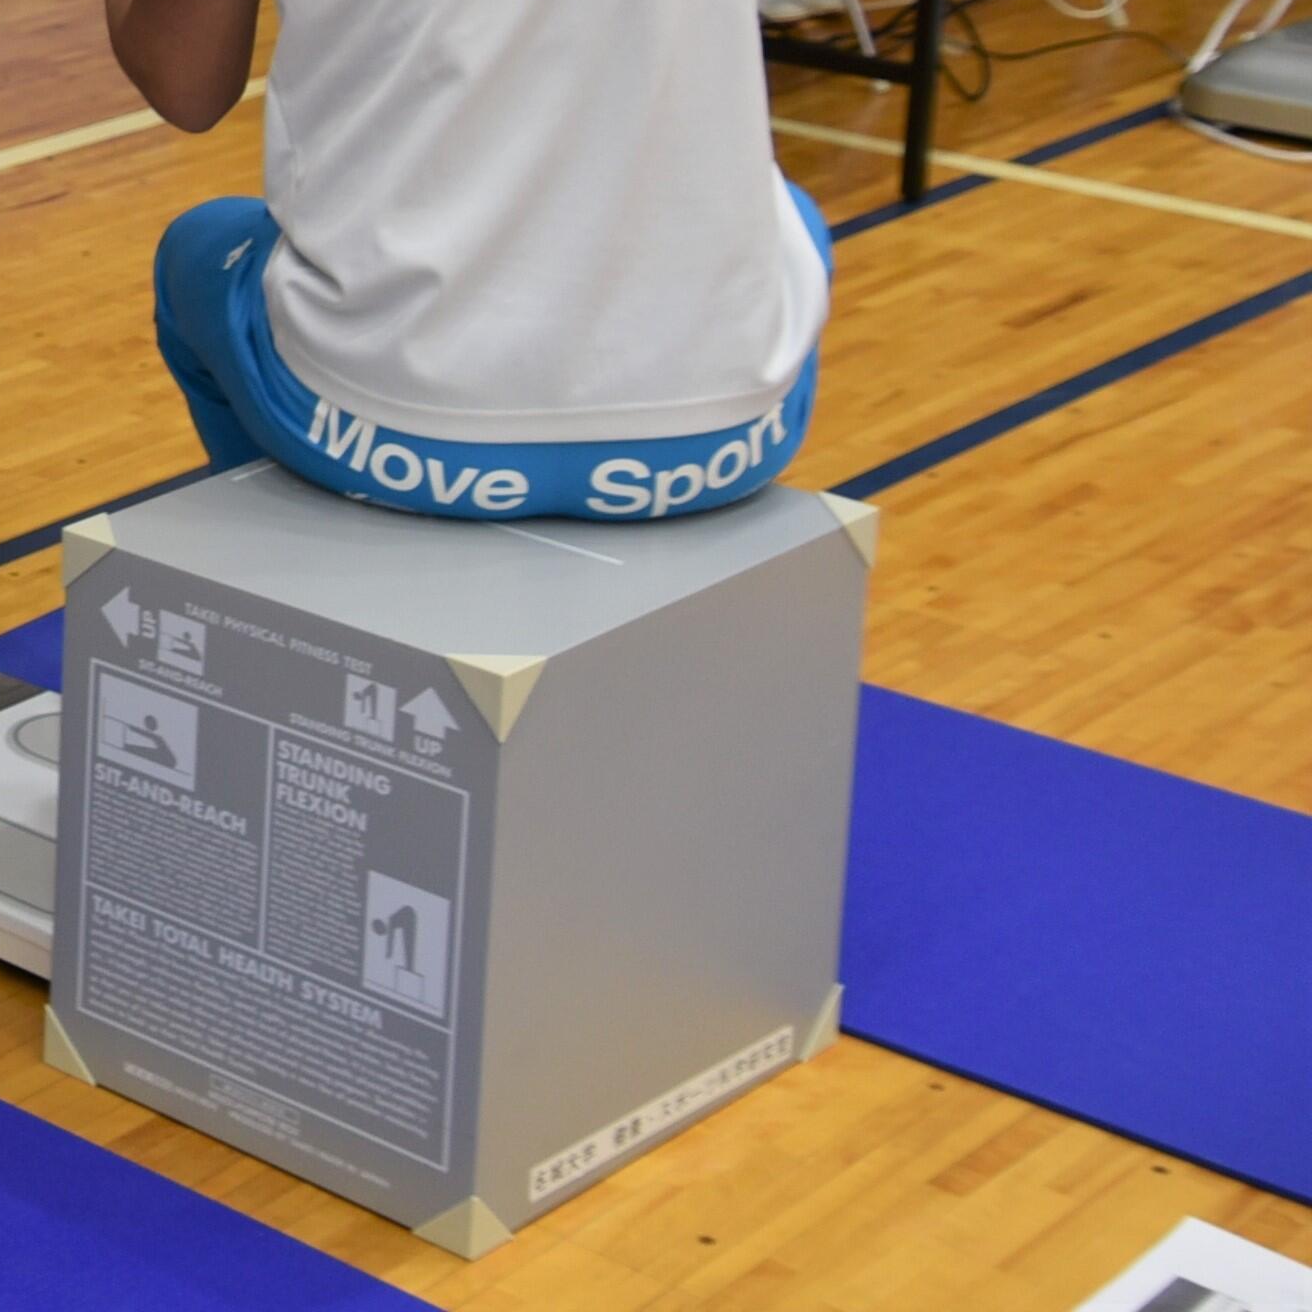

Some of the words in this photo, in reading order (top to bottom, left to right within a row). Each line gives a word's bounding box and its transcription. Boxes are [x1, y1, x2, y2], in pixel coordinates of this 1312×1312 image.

[307, 399, 529, 511] Move
[141, 610, 156, 639] UP
[223, 616, 287, 648] PHYSICAL
[290, 638, 340, 666] FITNESS
[343, 655, 373, 675] TEST
[278, 739, 391, 795] STANDING
[414, 736, 443, 757] UP
[94, 763, 248, 836] SIT-AND-REACH
[275, 783, 368, 832] FLEXION
[277, 761, 352, 804] TRUNK
[93, 895, 148, 931] TAKEI
[152, 919, 213, 959] TOTAL
[218, 946, 295, 993] HEALTH
[301, 980, 384, 1030] SYSTEM
